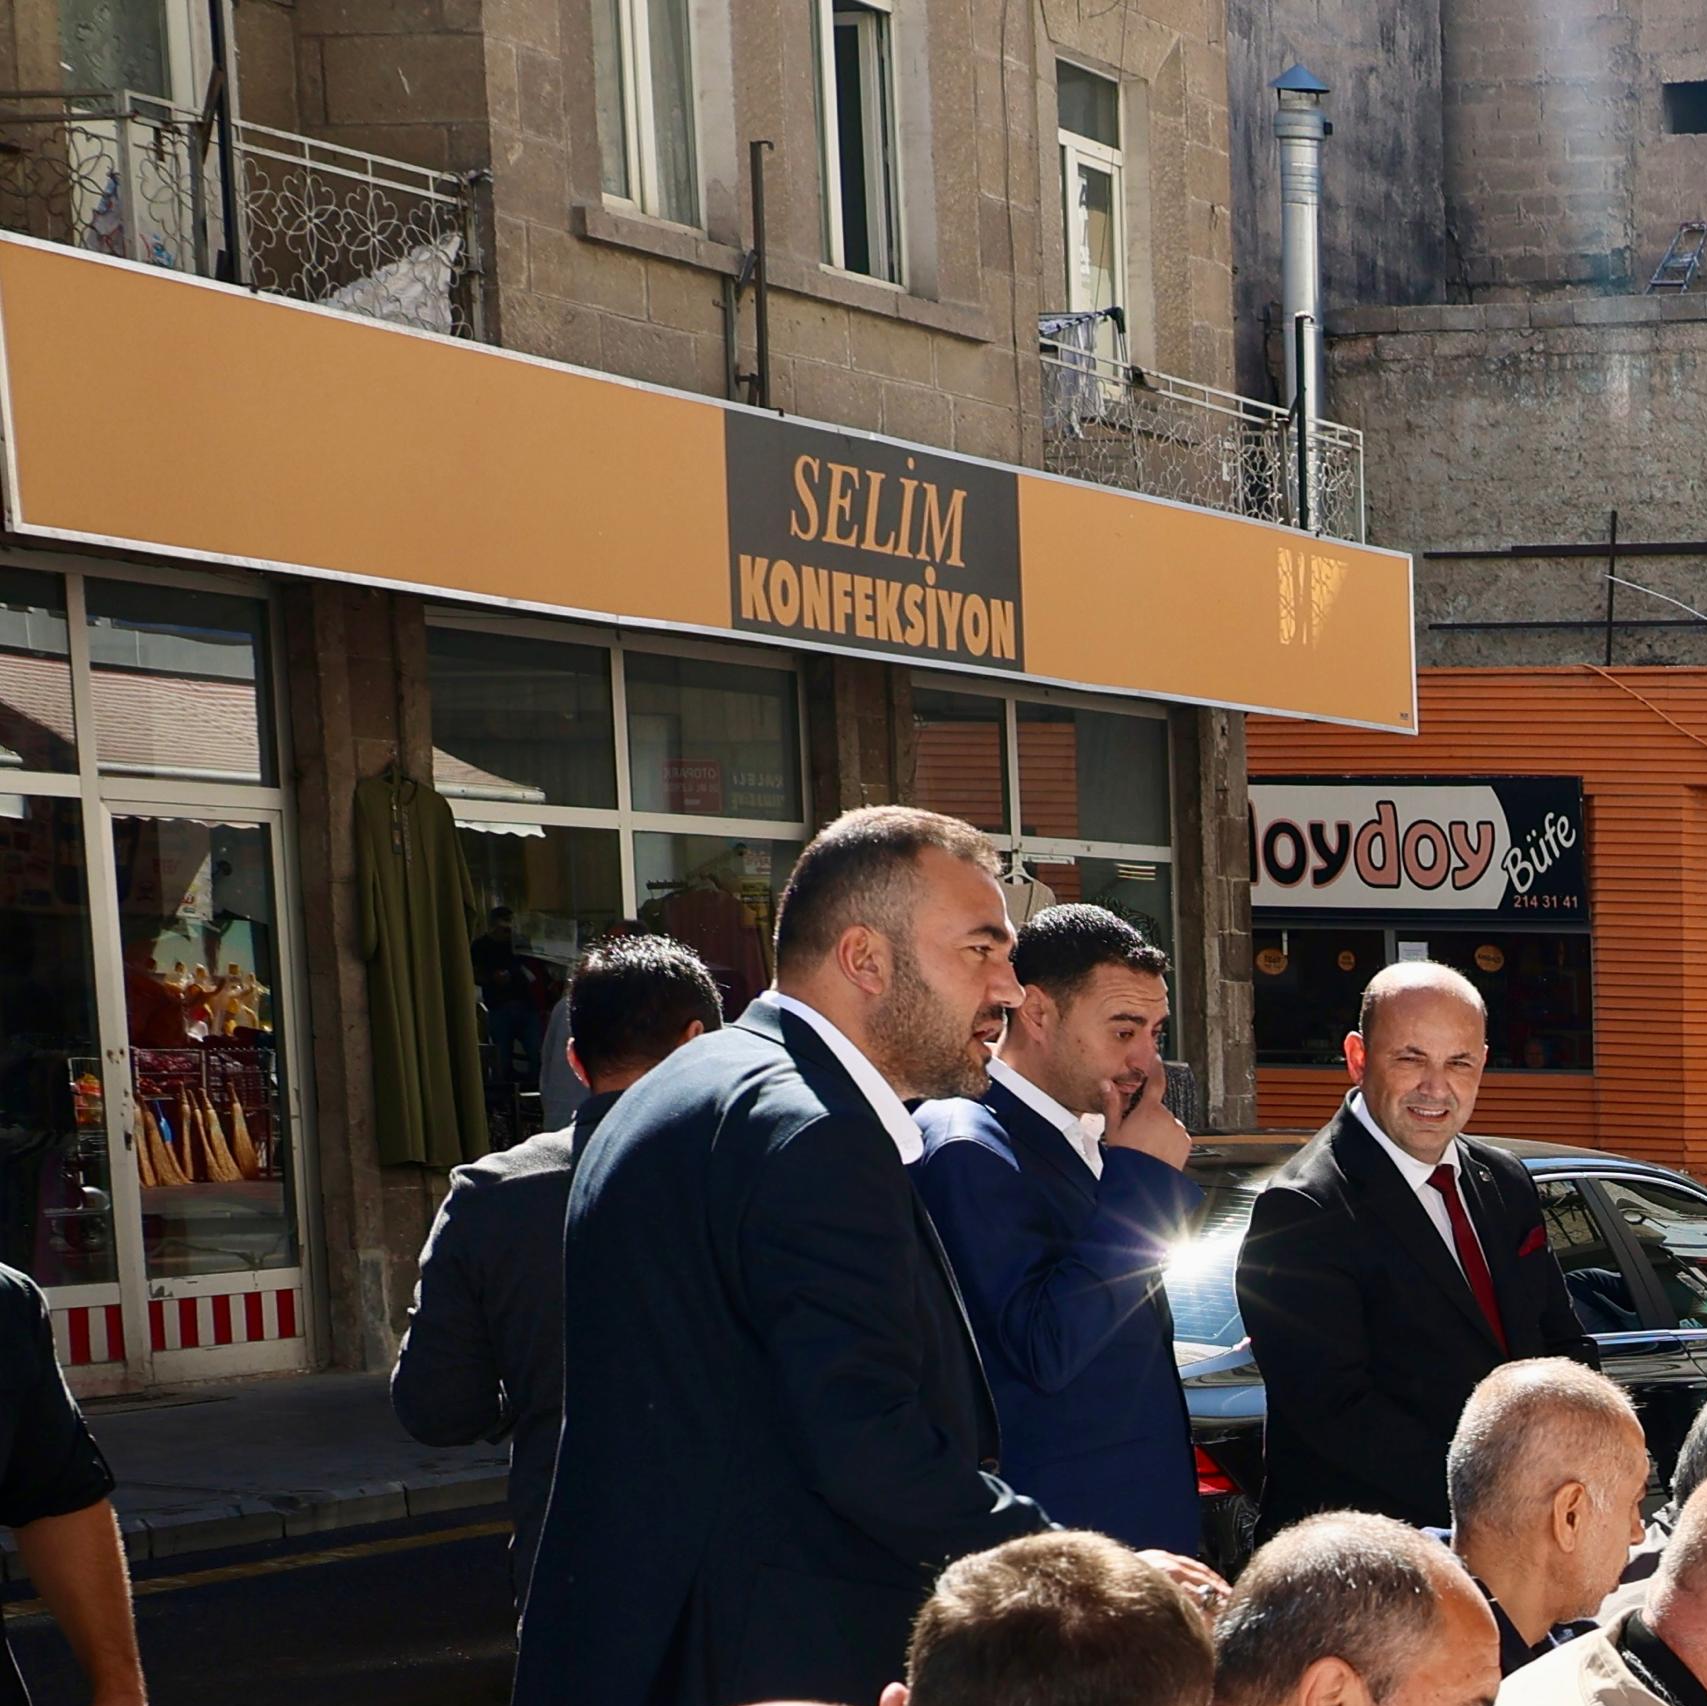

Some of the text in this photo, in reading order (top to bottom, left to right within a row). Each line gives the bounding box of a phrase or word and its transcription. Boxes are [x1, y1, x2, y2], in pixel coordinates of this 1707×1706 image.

[790, 453, 968, 569] SELİM
[739, 553, 1016, 661] KONFEKSİYON
[1502, 812, 1577, 894] Büfe
[1514, 895, 1578, 908] 214 31 41
